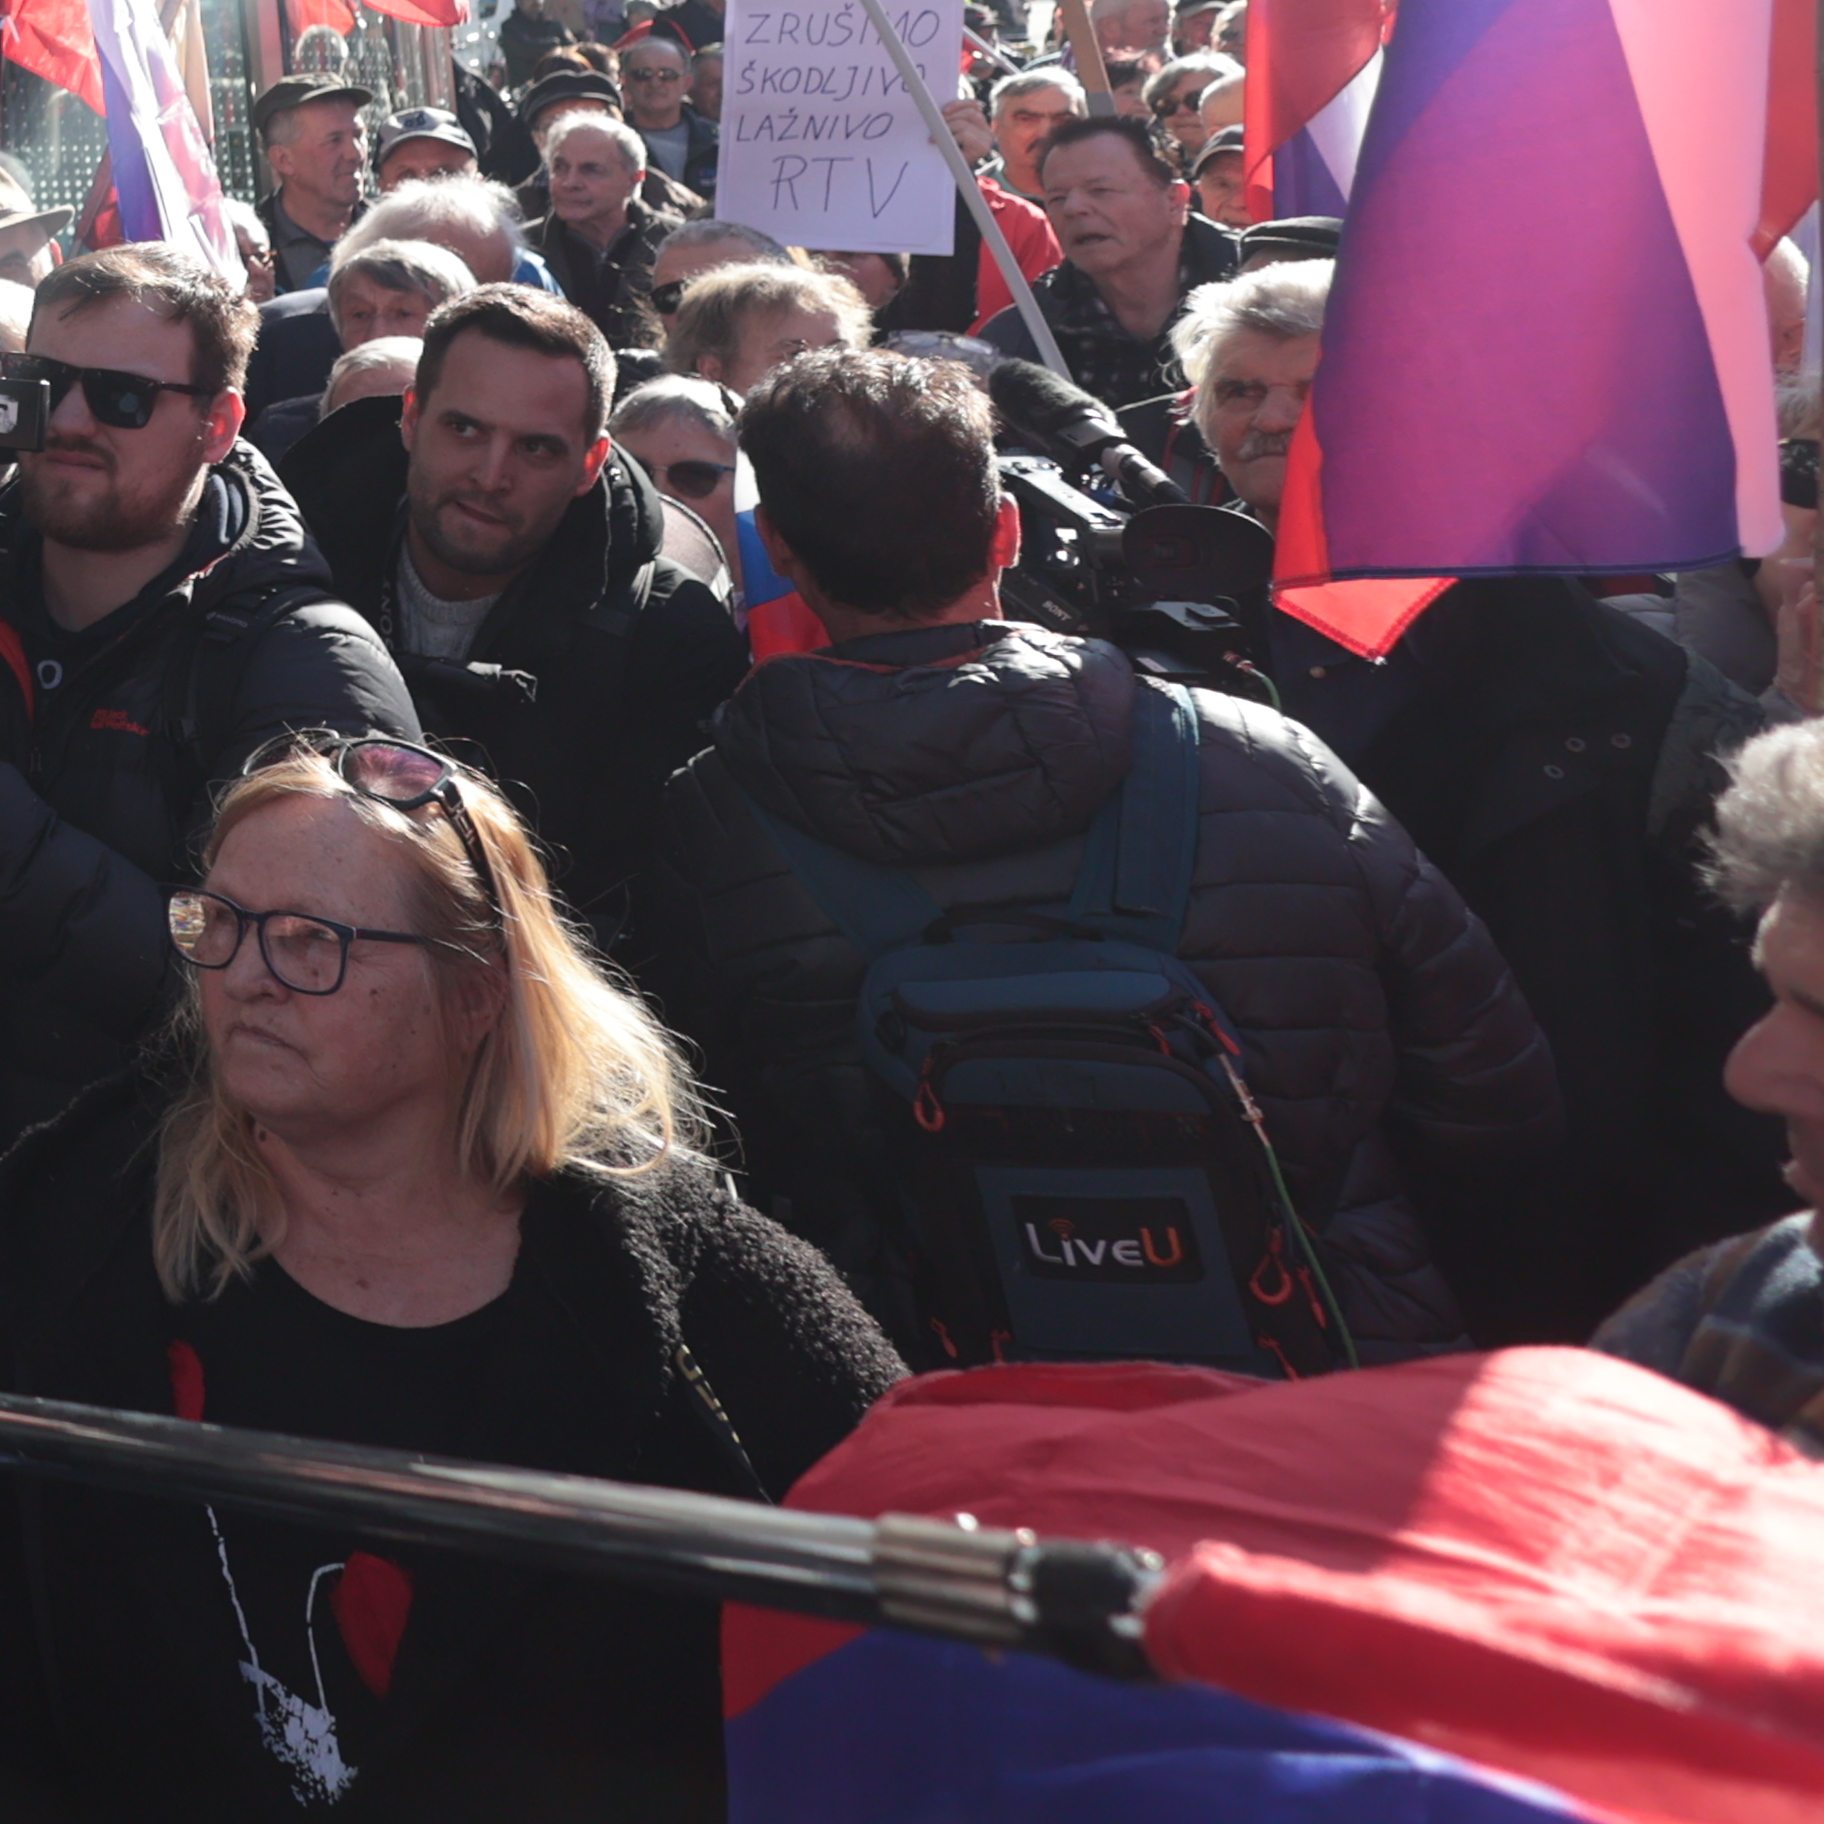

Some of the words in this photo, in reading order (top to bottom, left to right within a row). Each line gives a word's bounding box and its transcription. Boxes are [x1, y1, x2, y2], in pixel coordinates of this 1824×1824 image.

[735, 106, 895, 143] LAŽNIVO
[770, 154, 910, 219] RTV
[1042, 599, 1072, 622] SONY
